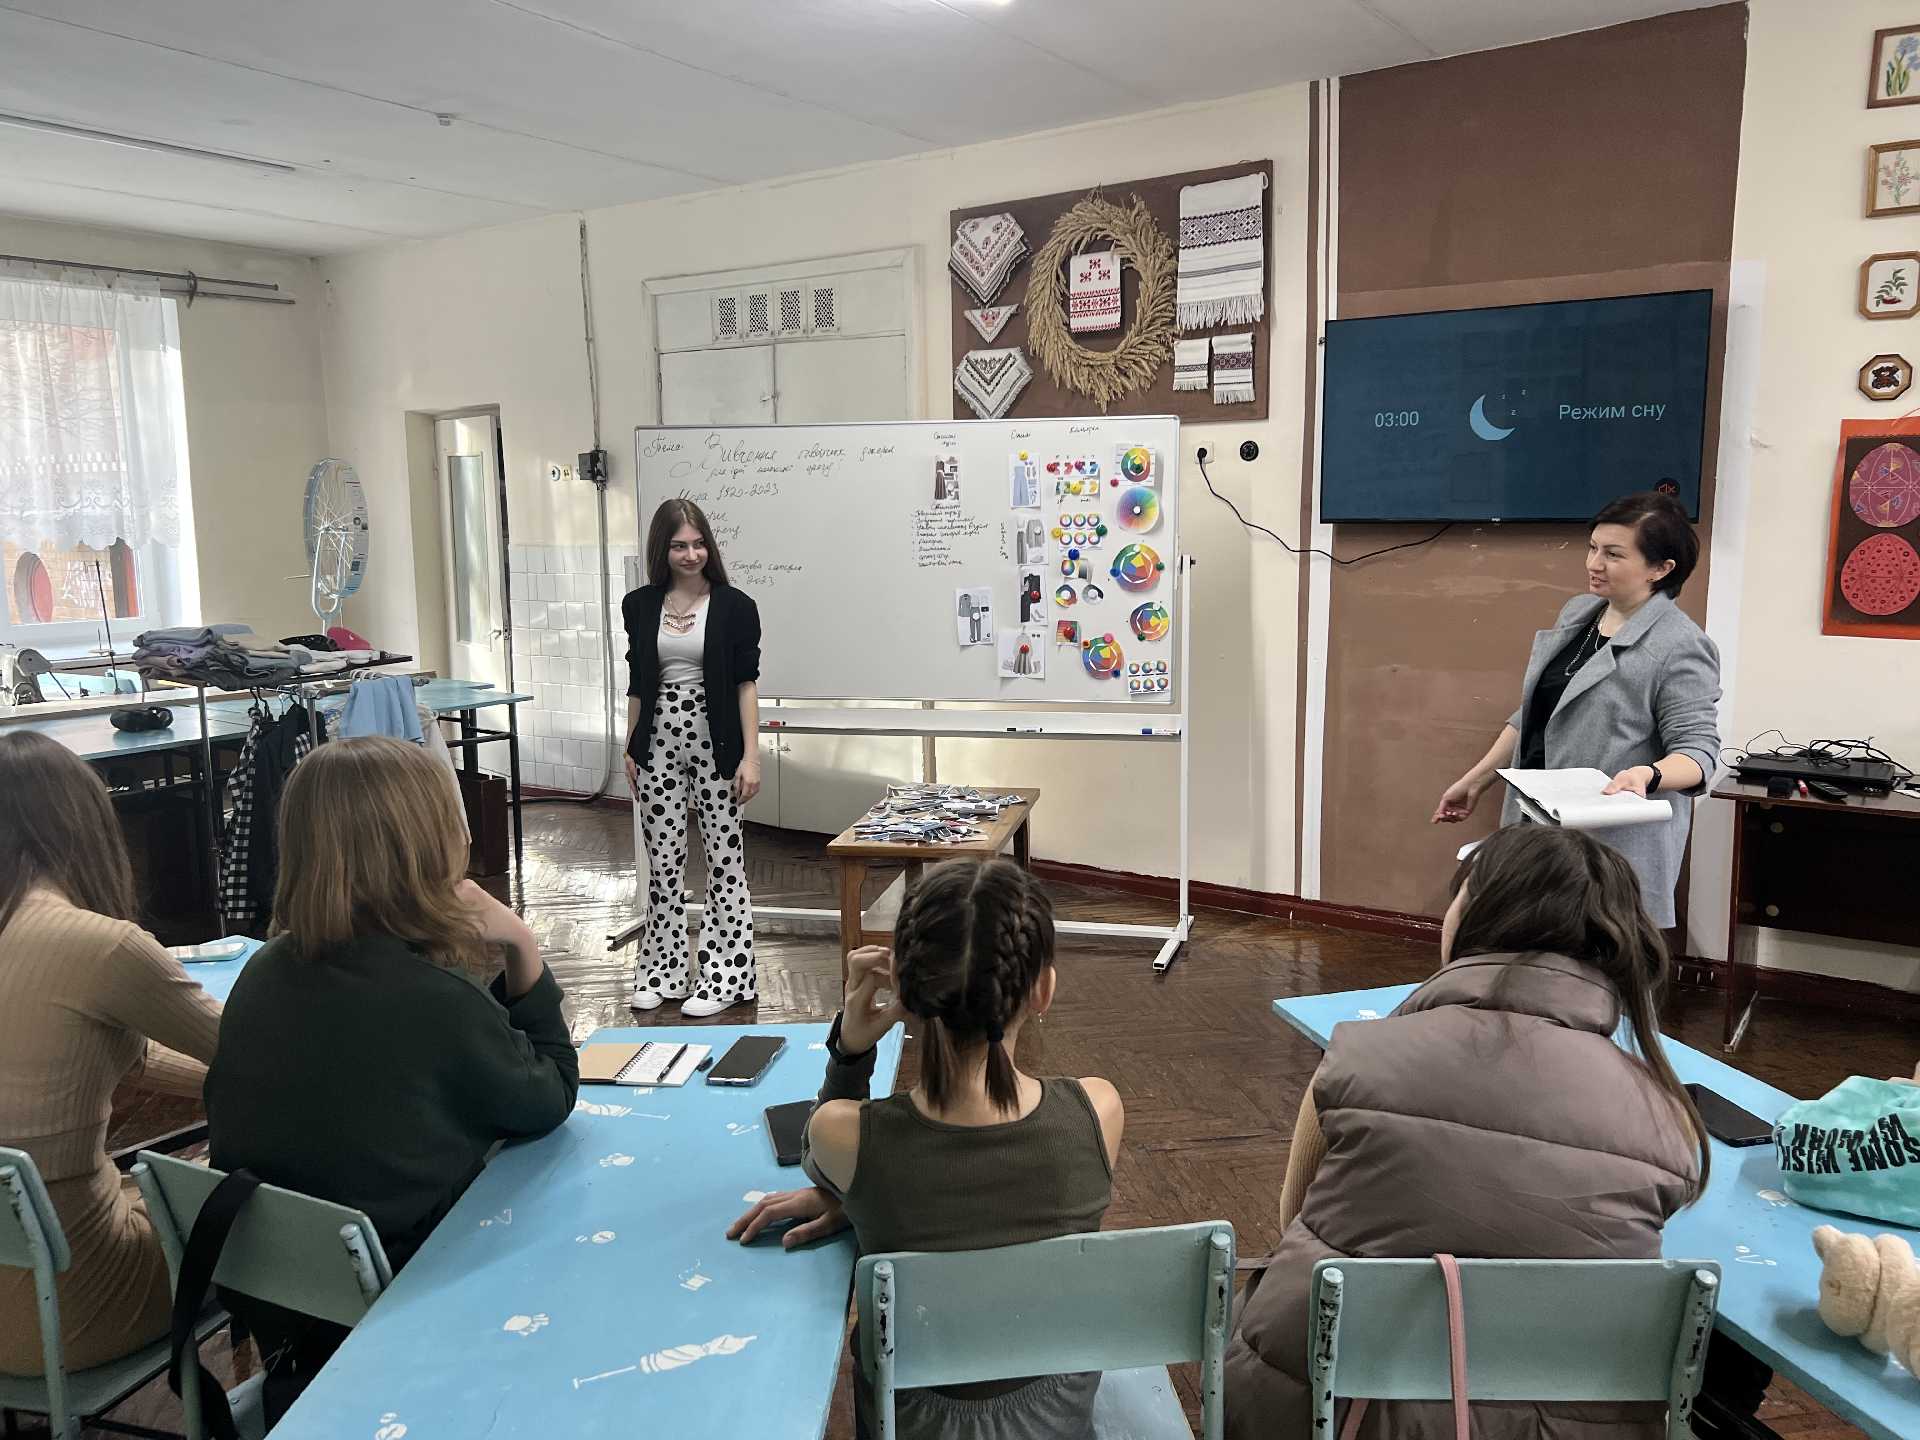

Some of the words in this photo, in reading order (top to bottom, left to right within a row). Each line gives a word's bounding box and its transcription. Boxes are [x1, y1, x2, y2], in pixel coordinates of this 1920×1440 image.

[1374, 411, 1419, 427] 03:00
[1559, 404, 1625, 420] Режим
[1631, 403, 1666, 420] сну
[1849, 1136, 1920, 1172] SOME
